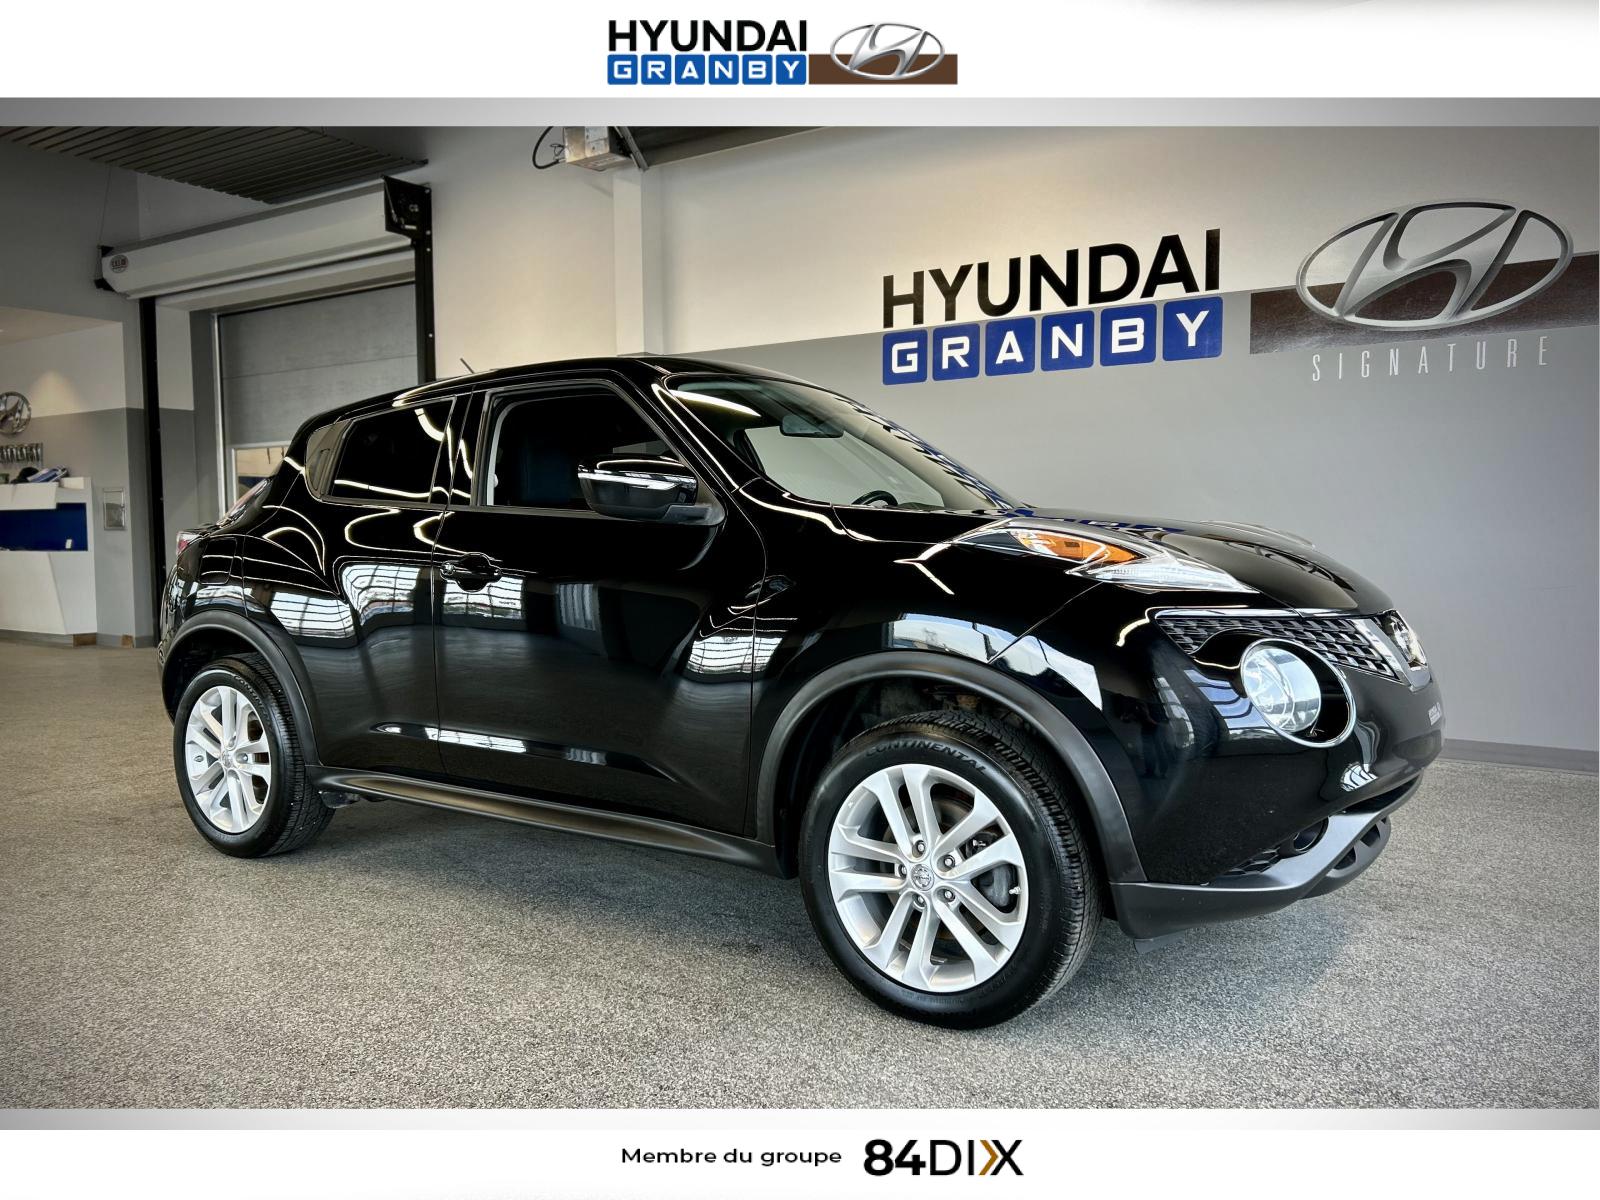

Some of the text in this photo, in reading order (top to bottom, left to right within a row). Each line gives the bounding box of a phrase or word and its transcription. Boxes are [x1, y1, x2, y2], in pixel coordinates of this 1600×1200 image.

[883, 228, 1221, 329] HYUNDAI
[891, 310, 1210, 374] GRANBY
[1312, 336, 1547, 382] SIGNATURE
[865, 740, 987, 776] CONTINENTAL
